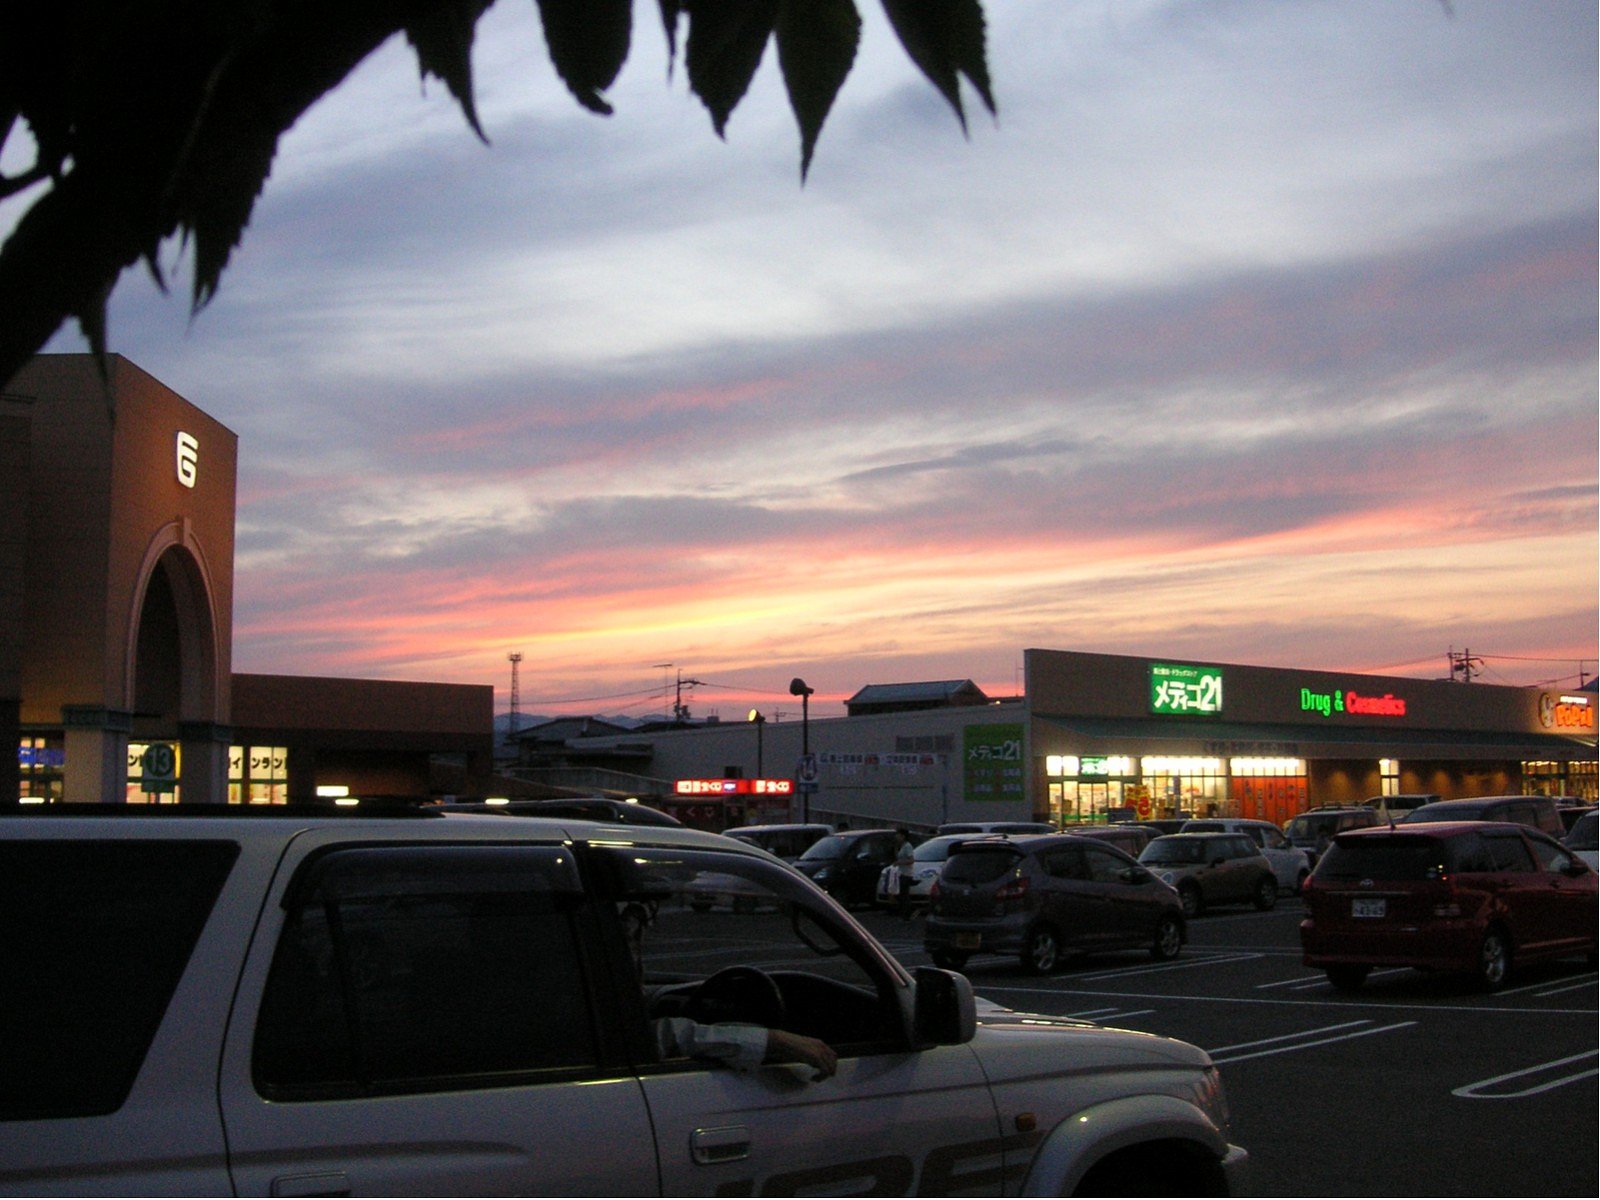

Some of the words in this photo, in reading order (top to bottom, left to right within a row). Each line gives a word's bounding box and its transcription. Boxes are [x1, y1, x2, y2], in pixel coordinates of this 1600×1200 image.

[1154, 674, 1222, 711] メディコ21
[1301, 688, 1331, 717] Drug
[1334, 690, 1344, 712] &
[149, 748, 170, 774] 13
[968, 739, 1020, 761] メディコ21
